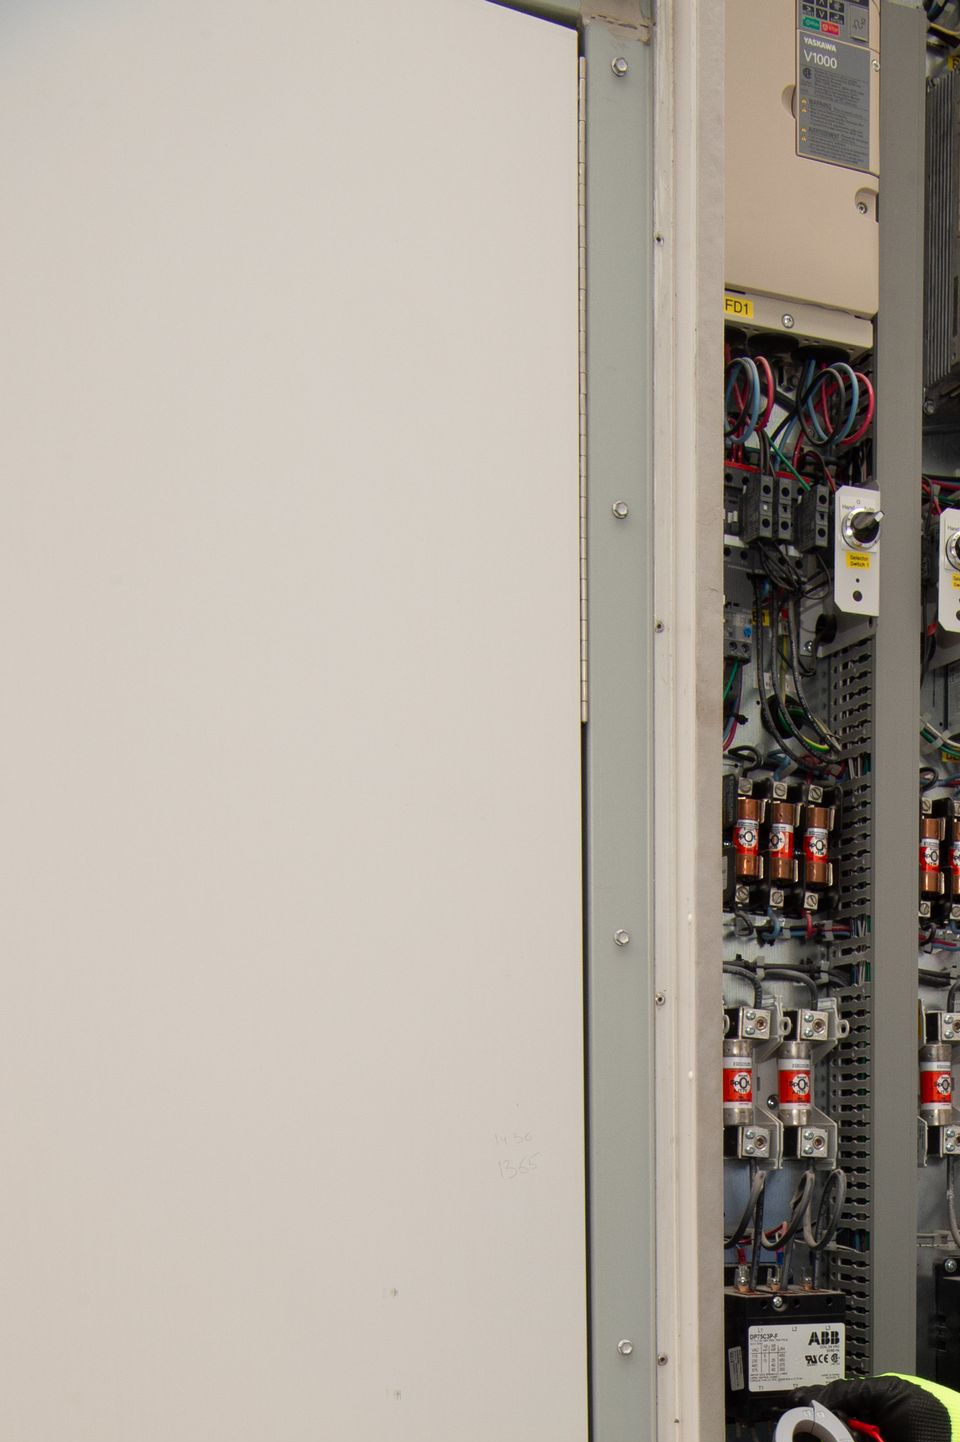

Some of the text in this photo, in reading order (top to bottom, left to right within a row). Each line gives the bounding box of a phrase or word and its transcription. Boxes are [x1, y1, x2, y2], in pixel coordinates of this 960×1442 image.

[804, 36, 836, 52] YASKAWA
[804, 49, 837, 69] V1000
[726, 298, 748, 315] FD1
[808, 1331, 840, 1345] ABB
